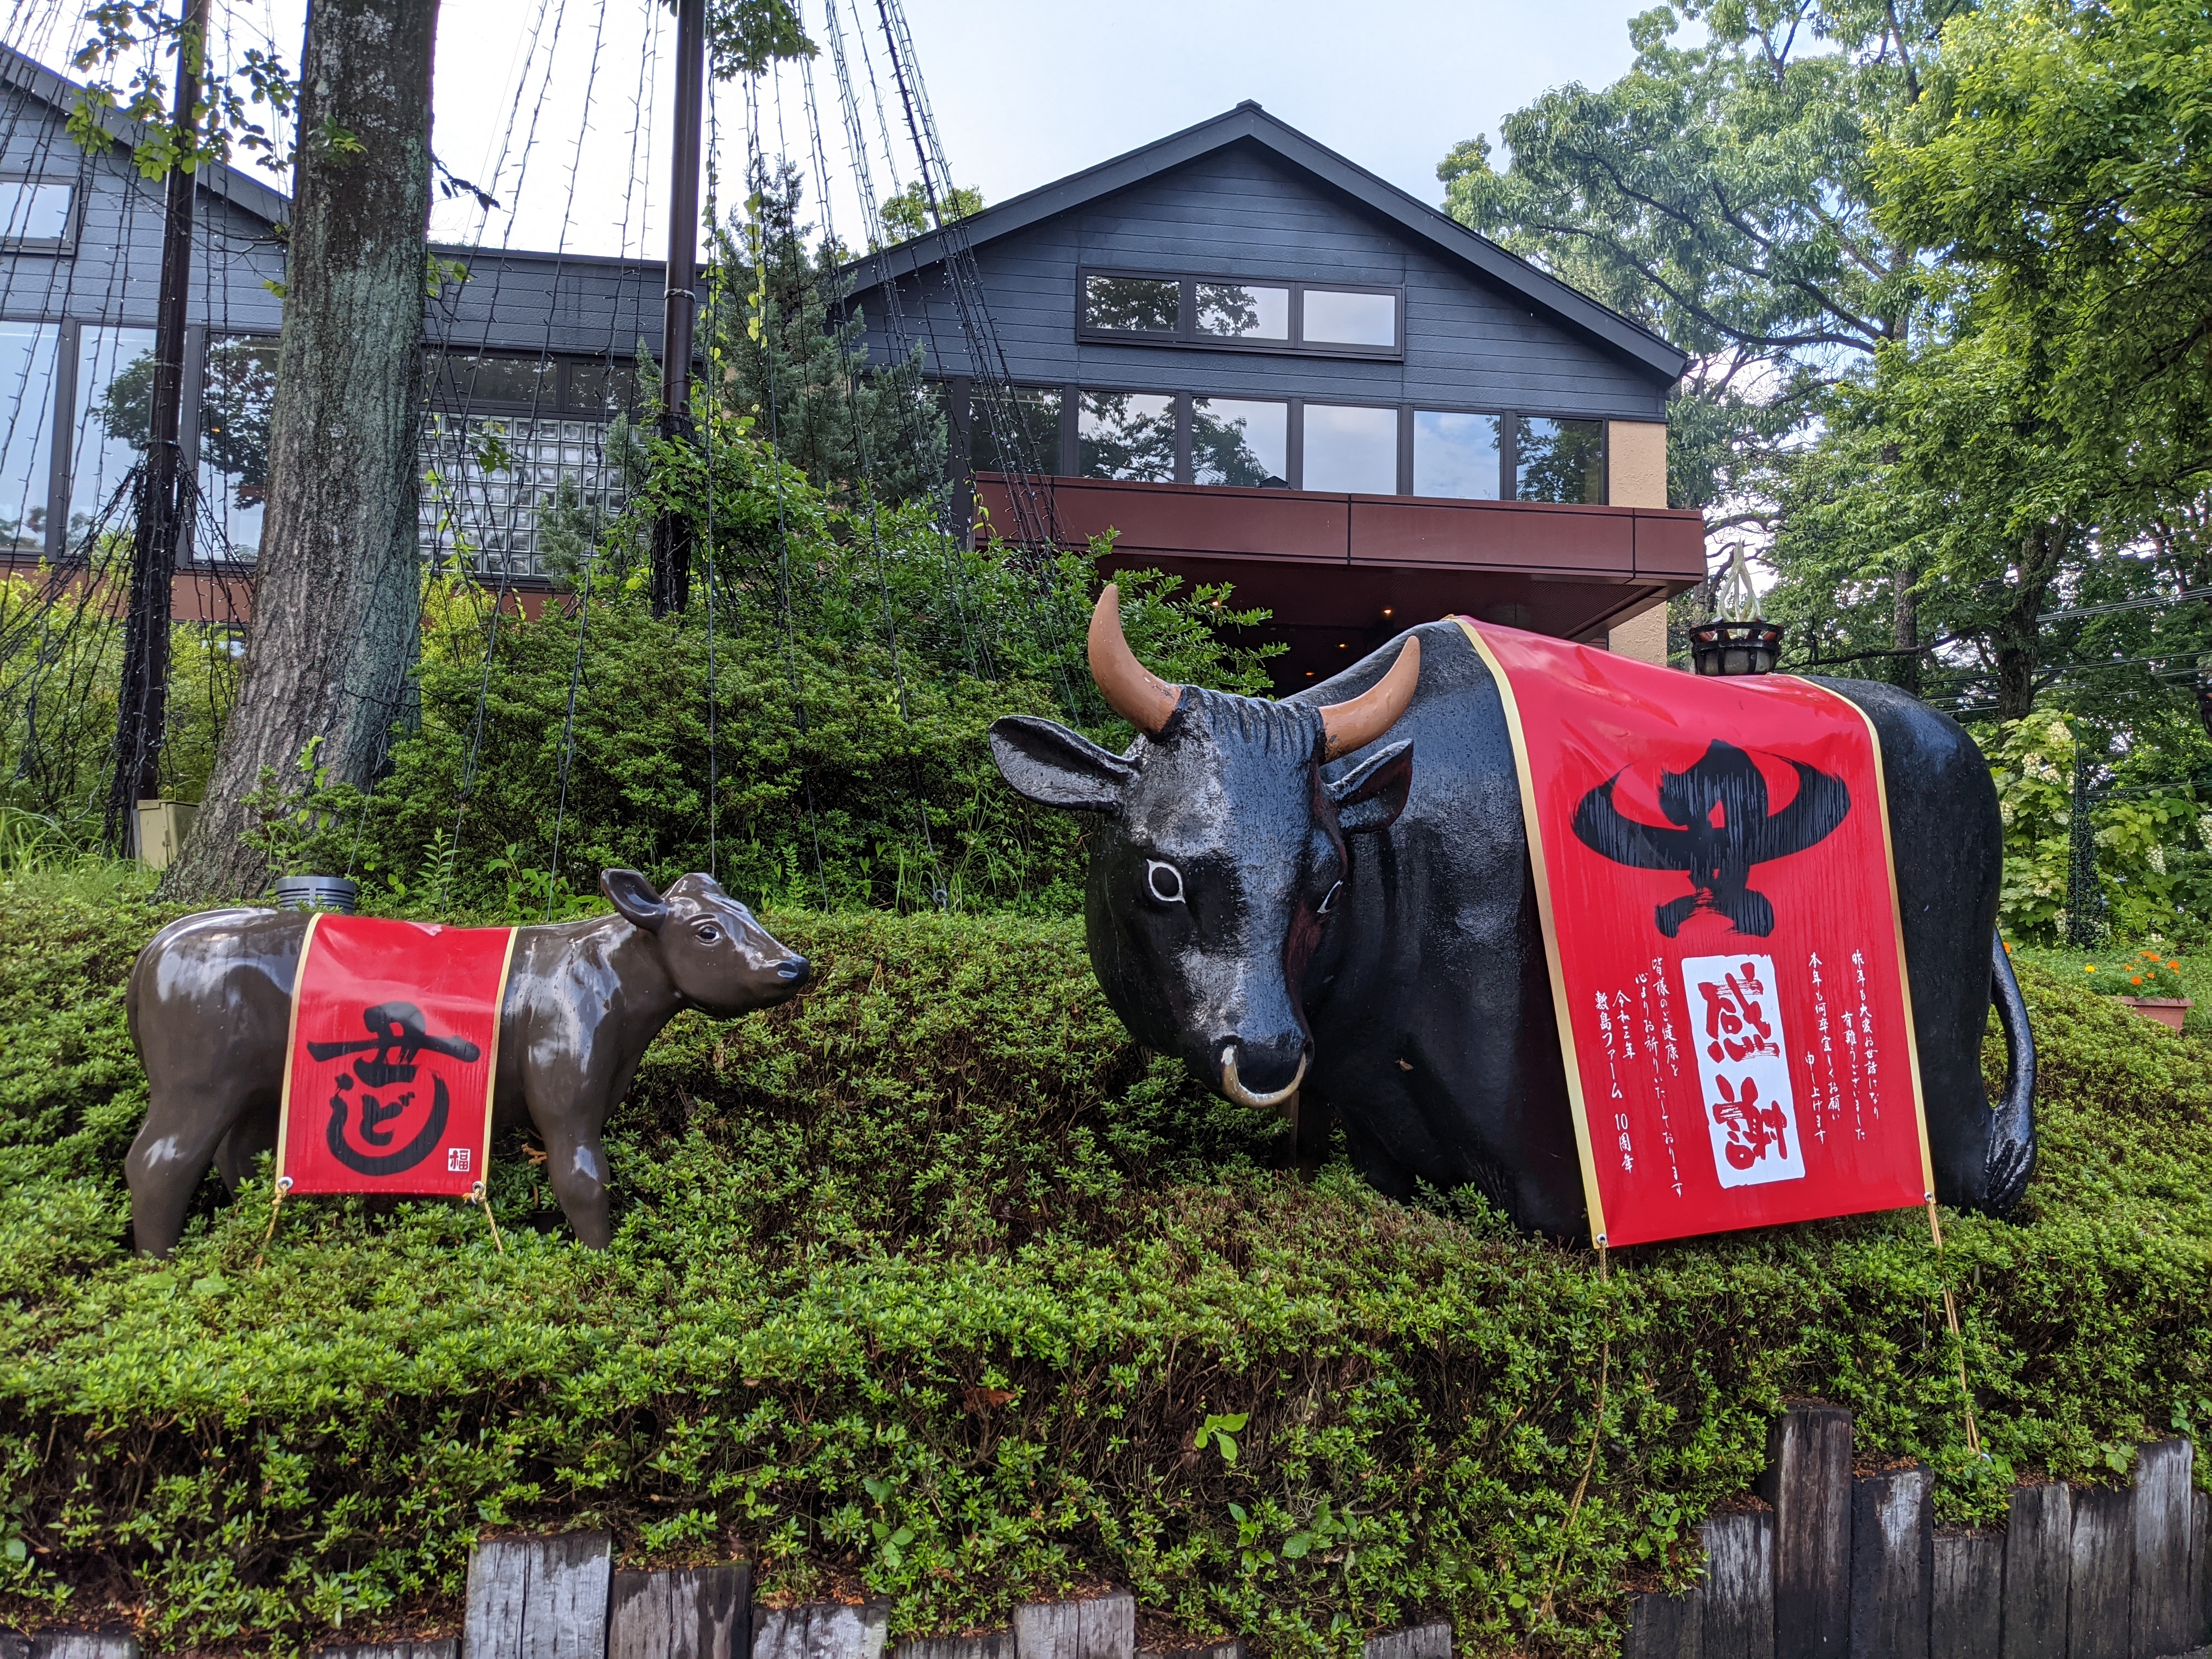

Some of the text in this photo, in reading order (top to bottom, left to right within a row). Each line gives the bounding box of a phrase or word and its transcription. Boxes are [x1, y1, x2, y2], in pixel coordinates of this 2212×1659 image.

[1595, 990, 1622, 1098] 敷島ファーム
[1612, 990, 1636, 1060] 令和三年
[1651, 957, 1679, 1076] 皆様のご健康を
[1697, 962, 1787, 1170] 感謝
[1808, 951, 1841, 1120] 本年も何卒宜しくお願い
[1841, 1011, 1865, 1141] 有難うございました
[1852, 949, 1878, 1120] 昨年も大変お世話になり
[1635, 973, 1683, 1198] 心よりお祈りいたしております
[1804, 1051, 1826, 1145] 申し上げます
[449, 1149, 469, 1170] 福
